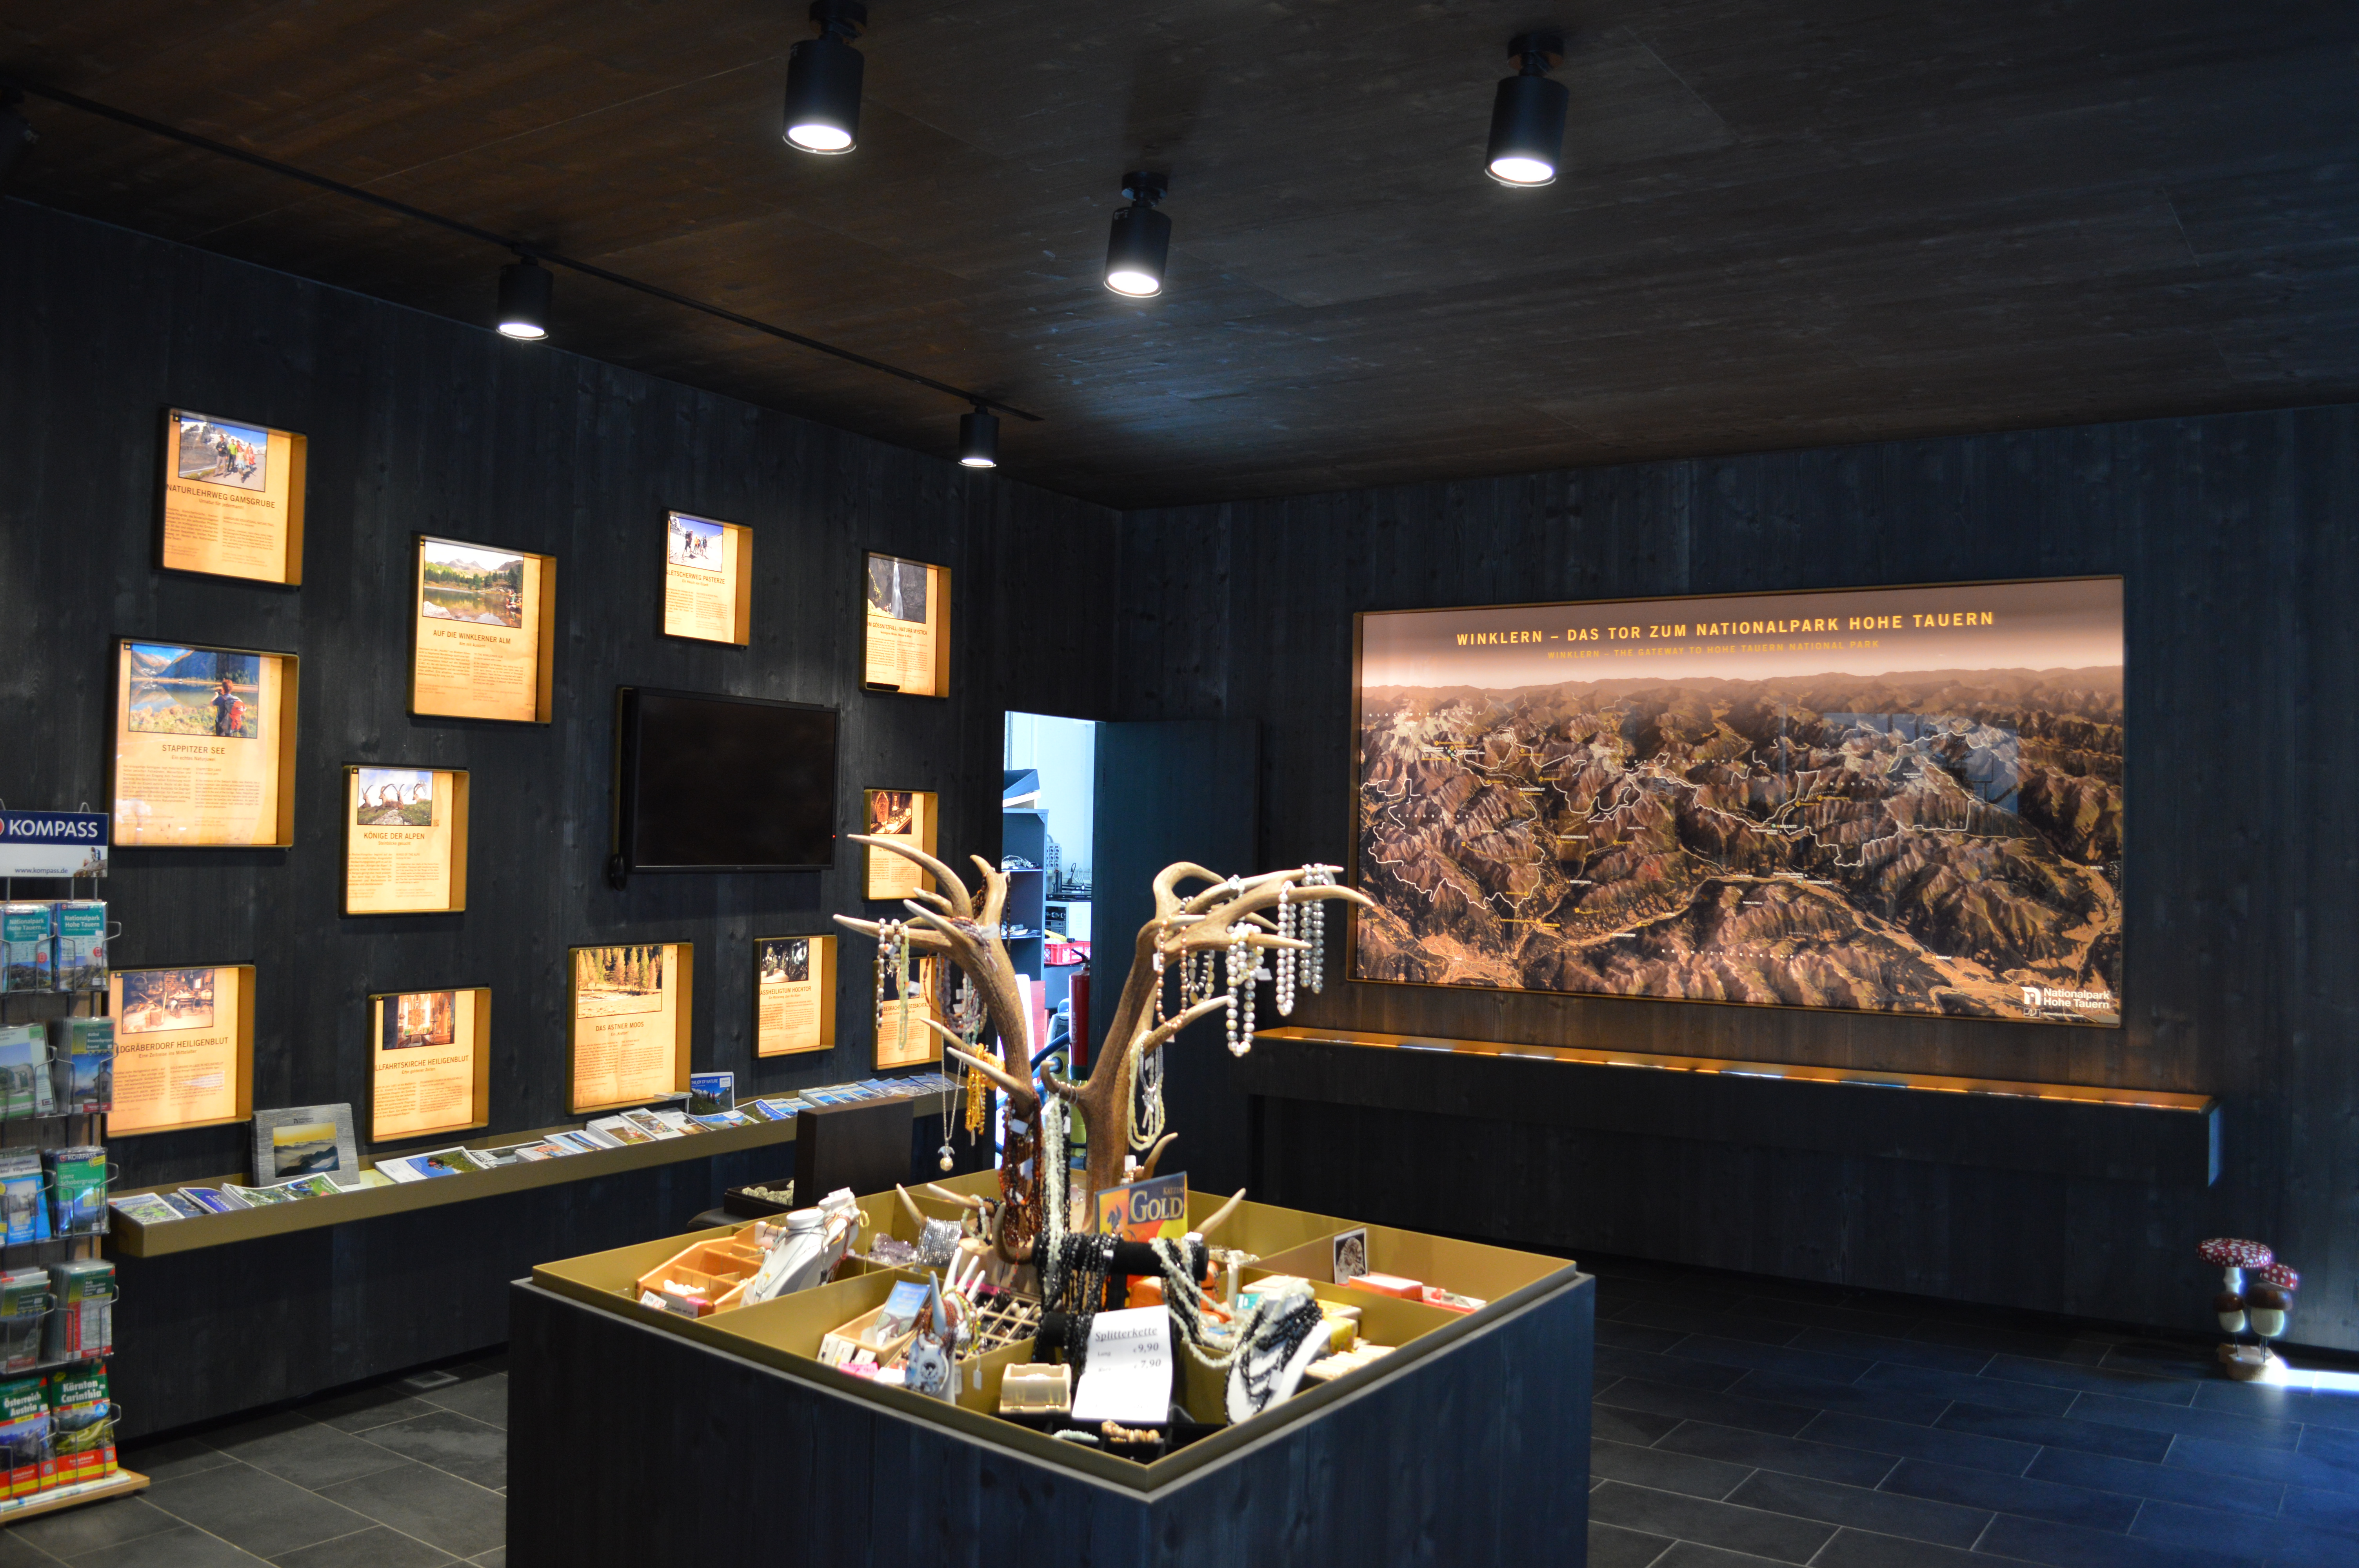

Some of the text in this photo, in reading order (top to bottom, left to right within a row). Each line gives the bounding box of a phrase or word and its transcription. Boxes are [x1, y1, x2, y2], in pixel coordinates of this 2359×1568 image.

[167, 485, 276, 509] NATURLEHRWEG GAMSGRUBE
[703, 575, 725, 584] PASTERZE
[1457, 630, 1542, 645] WINKLERN
[1568, 628, 1599, 641] DAS
[1608, 626, 1640, 639] TOR
[1650, 624, 1686, 637] ZUM
[1696, 618, 1839, 636] NATIONALPARK
[1849, 615, 1902, 630] HOHE
[1913, 612, 1992, 628] TAUERN
[459, 632, 497, 643] WINKLERNER
[1547, 650, 1600, 659] WINKLERN
[1614, 648, 1632, 657] THE
[1638, 647, 1684, 656] GATEWAY
[1707, 645, 1736, 653] HOHE
[1741, 644, 1783, 652] TAUERN
[1789, 642, 1844, 651] NATIONAL
[1850, 640, 1879, 649] PARK
[162, 744, 208, 753] STAPPITZER
[9, 819, 98, 838] KOMPASS
[363, 831, 388, 840] KÖNIGE
[2043, 987, 2110, 1001] Nationalpark
[2043, 997, 2110, 1009] Hohe Tauern
[177, 1037, 229, 1049] HEILIGENBLUT
[375, 1055, 469, 1071] LLFAHRTSKIRCHE HEILIGENBLUT
[1095, 1328, 1158, 1342] Splitterkette
[1138, 1342, 1159, 1353] 9,90
[1141, 1358, 1161, 1369] 7,90
[62, 1379, 98, 1392] Kärnten
[4, 1391, 42, 1407] Österreich
[61, 1389, 102, 1403] Carinthia
[10, 1403, 38, 1417] Austria
